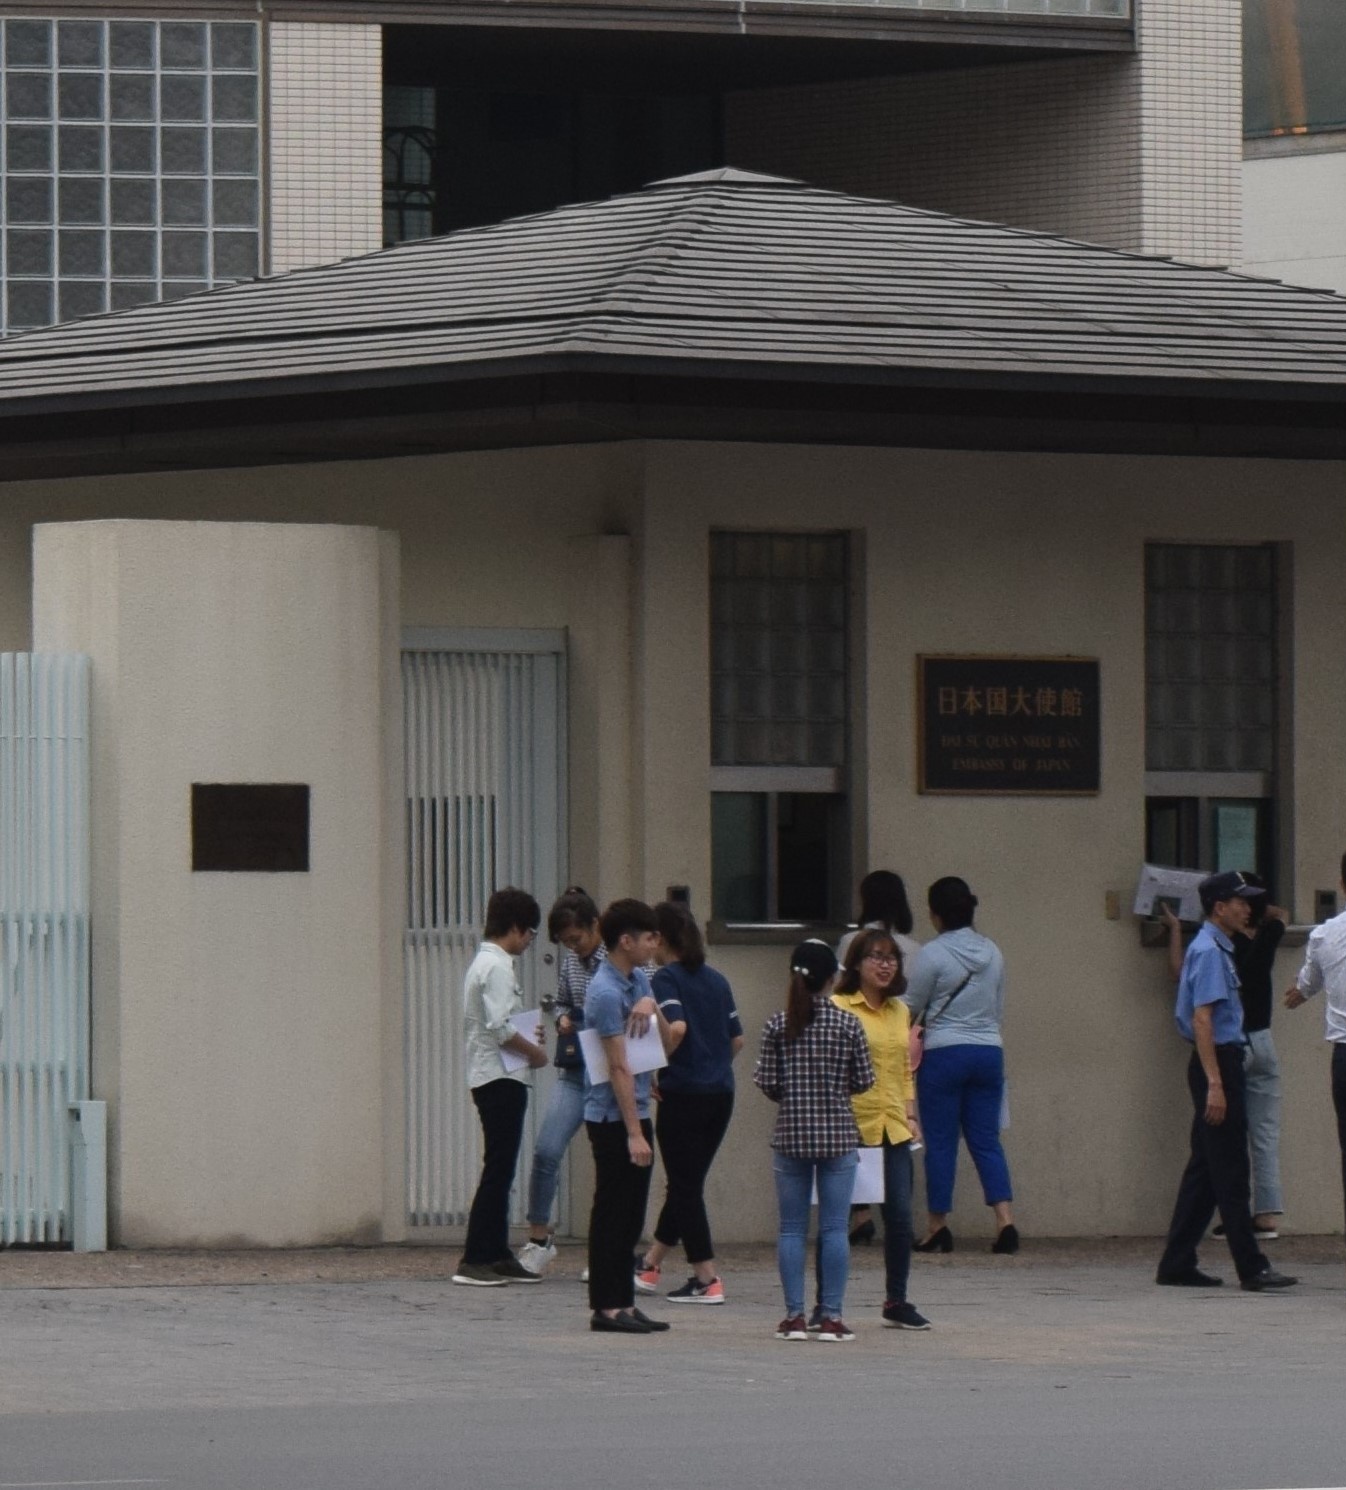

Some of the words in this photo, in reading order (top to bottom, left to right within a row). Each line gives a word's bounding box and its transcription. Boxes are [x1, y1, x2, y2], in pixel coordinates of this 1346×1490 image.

[939, 686, 1083, 717] 日本国大使館
